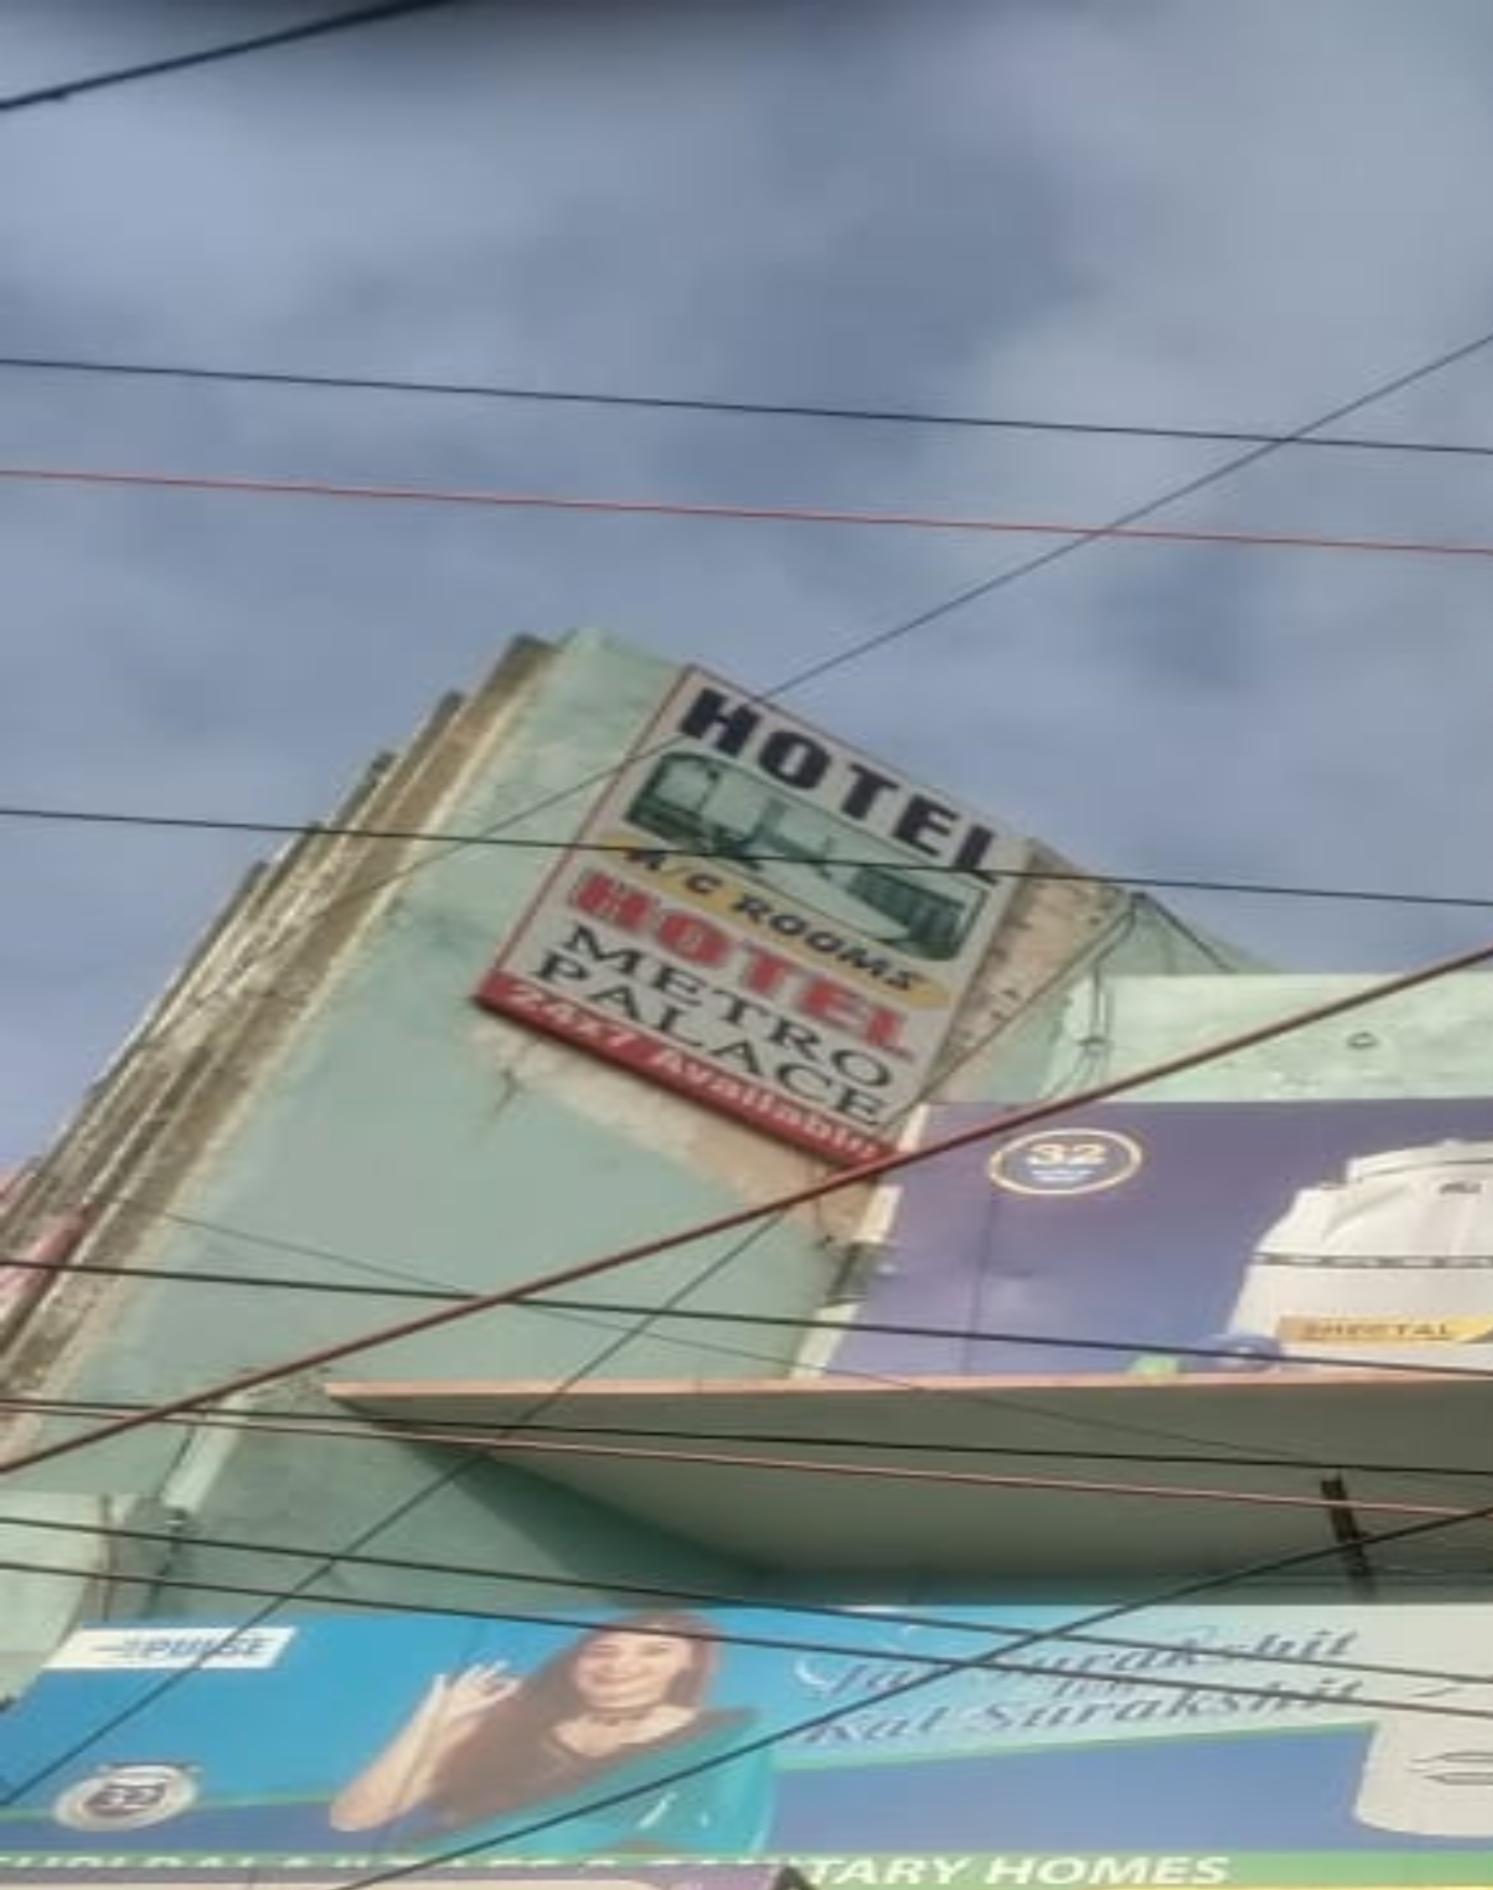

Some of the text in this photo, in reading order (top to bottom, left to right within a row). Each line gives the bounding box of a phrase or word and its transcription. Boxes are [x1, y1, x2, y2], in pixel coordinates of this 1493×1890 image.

[678, 686, 1000, 884] HOTEL
[560, 924, 895, 1092] METRO
[568, 868, 916, 1062] HOTEL
[730, 892, 922, 992] ROOMS
[531, 950, 888, 1129] PALACE
[1025, 1142, 1107, 1166] 32
[984, 1856, 1230, 1885] HOMES
